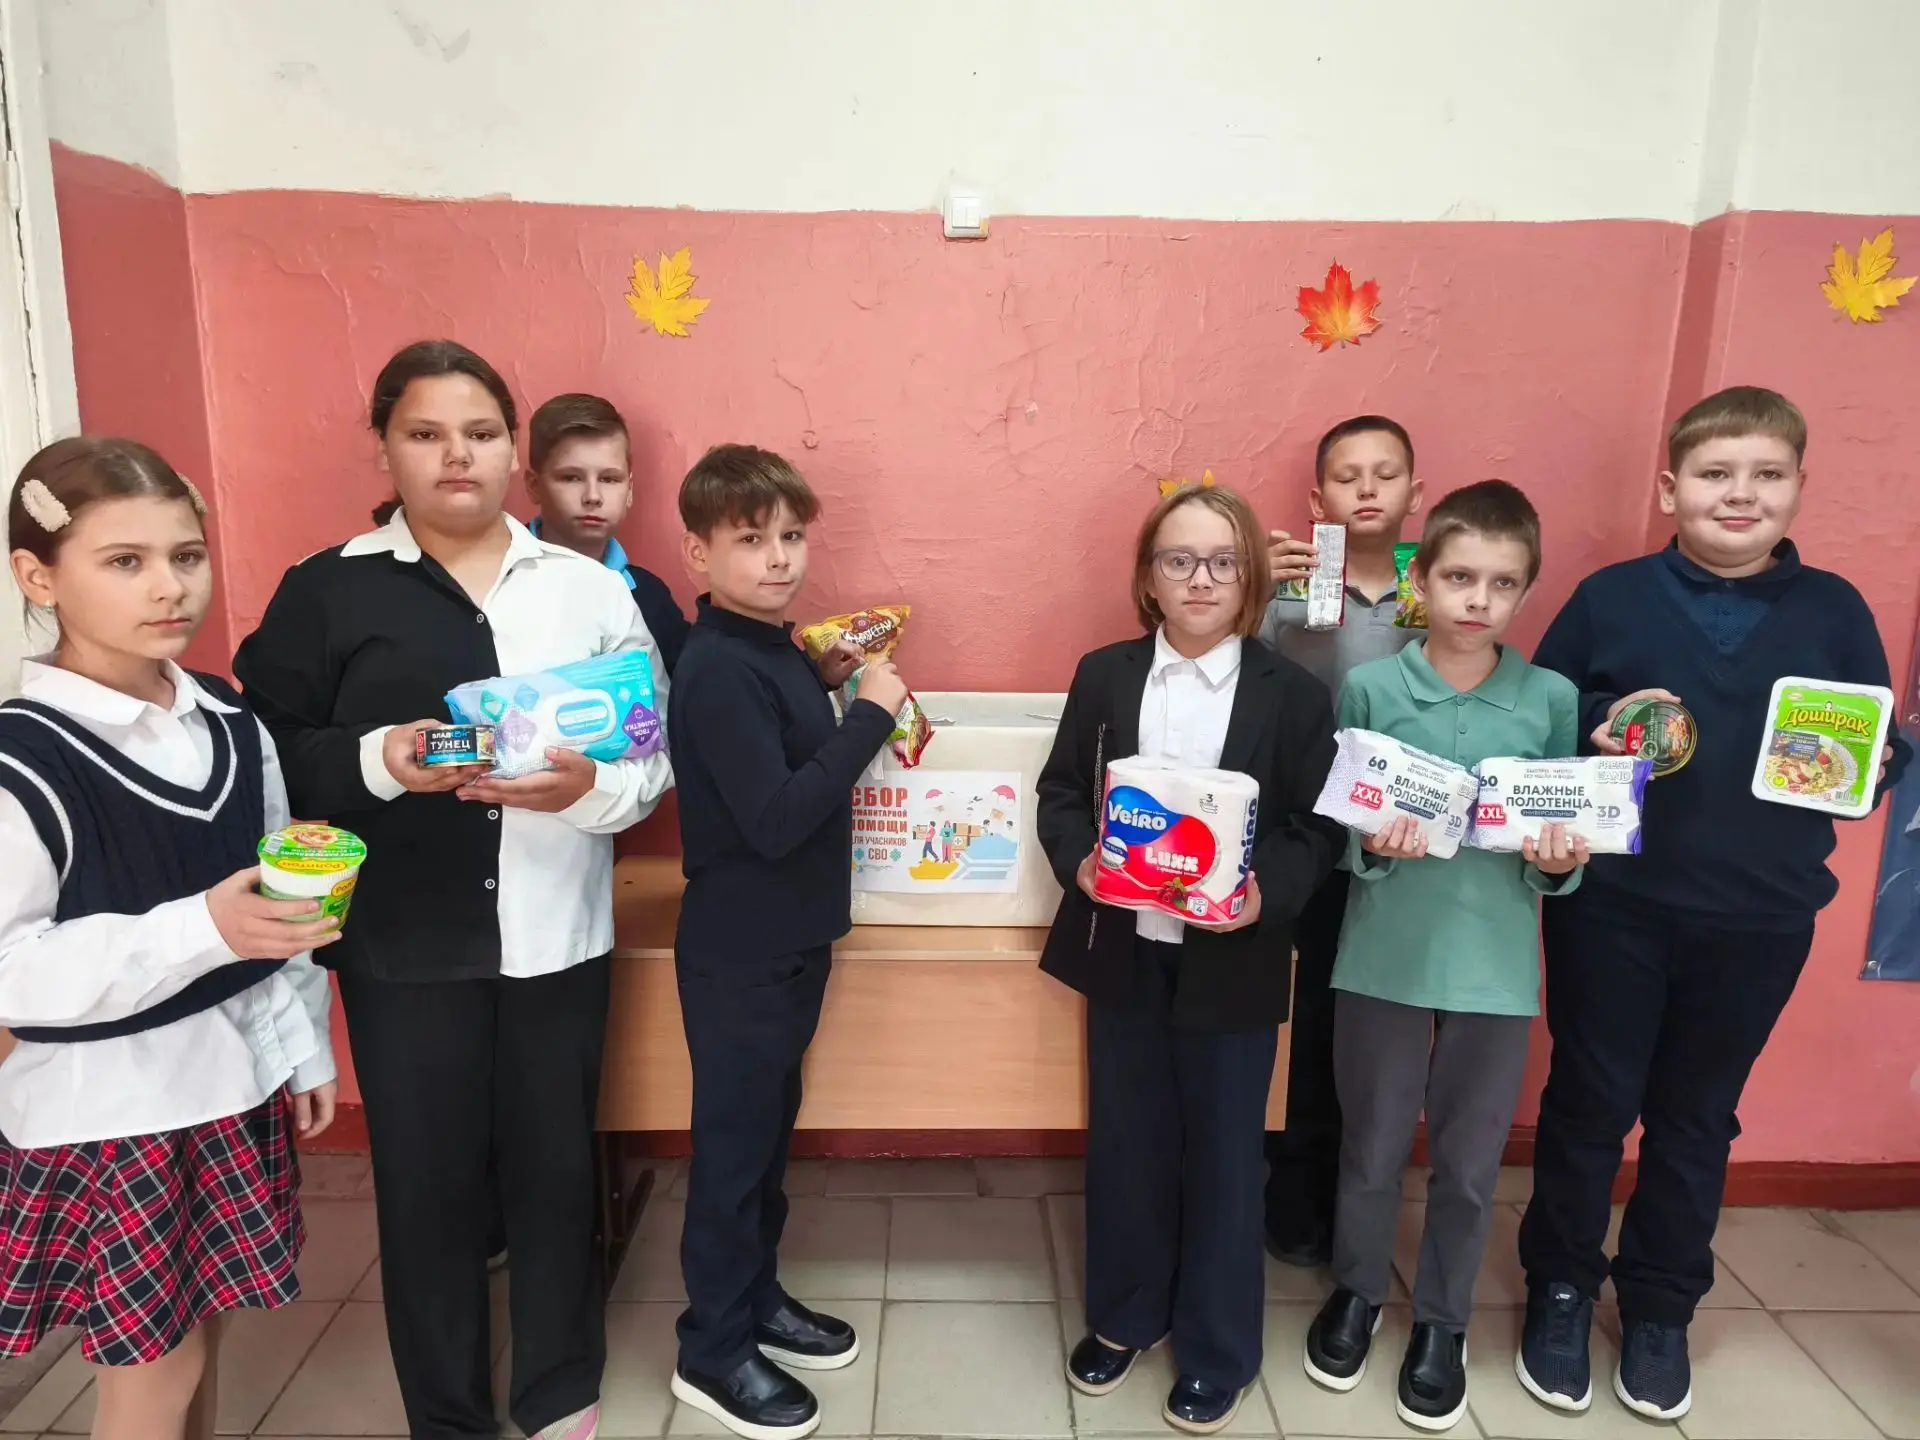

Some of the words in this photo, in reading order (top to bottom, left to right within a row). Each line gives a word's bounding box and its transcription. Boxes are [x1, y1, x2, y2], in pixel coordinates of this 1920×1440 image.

[1780, 708, 1871, 737] Доширак
[430, 740, 470, 750] ТУНЕЦ
[1368, 756, 1387, 771] 60
[1480, 775, 1498, 787] 60
[1354, 784, 1382, 805] XXL
[1395, 775, 1450, 803] ВЛАЖНЫЕ
[1513, 785, 1585, 796] ВЛАЖНЫЕ
[852, 786, 908, 808] СБОР
[1207, 793, 1214, 802] 3
[1386, 785, 1449, 815] ПОЛОТЕНЦА
[1506, 797, 1593, 810] ПОЛОТЕНЦА
[852, 808, 908, 818] УМАНИТАРНОЙ
[1477, 806, 1504, 820] XXL
[1597, 805, 1620, 819] 3D
[1448, 814, 1462, 828] 3D
[852, 835, 864, 845] ЛЯ
[868, 847, 888, 861] СВО
[1145, 846, 1199, 873] Luxx
